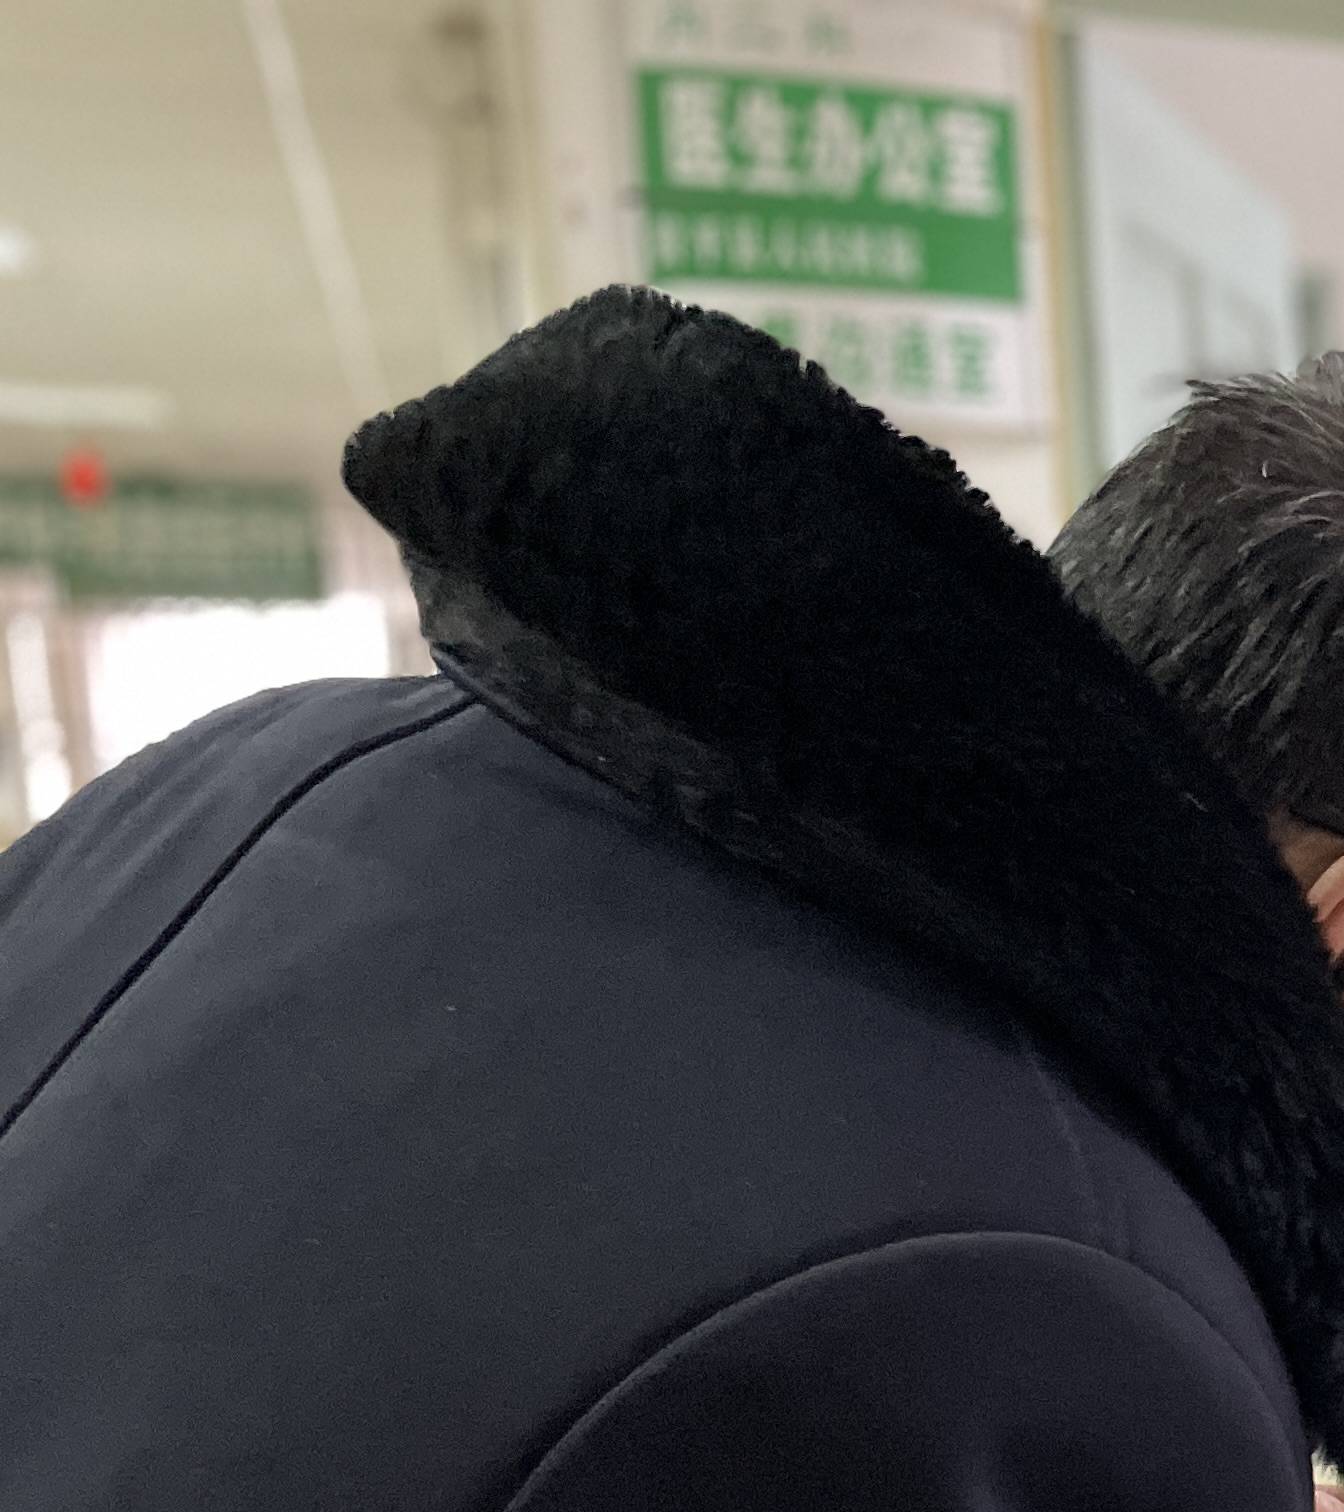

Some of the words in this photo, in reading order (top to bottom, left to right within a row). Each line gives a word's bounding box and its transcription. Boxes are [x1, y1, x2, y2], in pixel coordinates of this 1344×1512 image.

[660, 78, 1001, 216] 医生办公室
